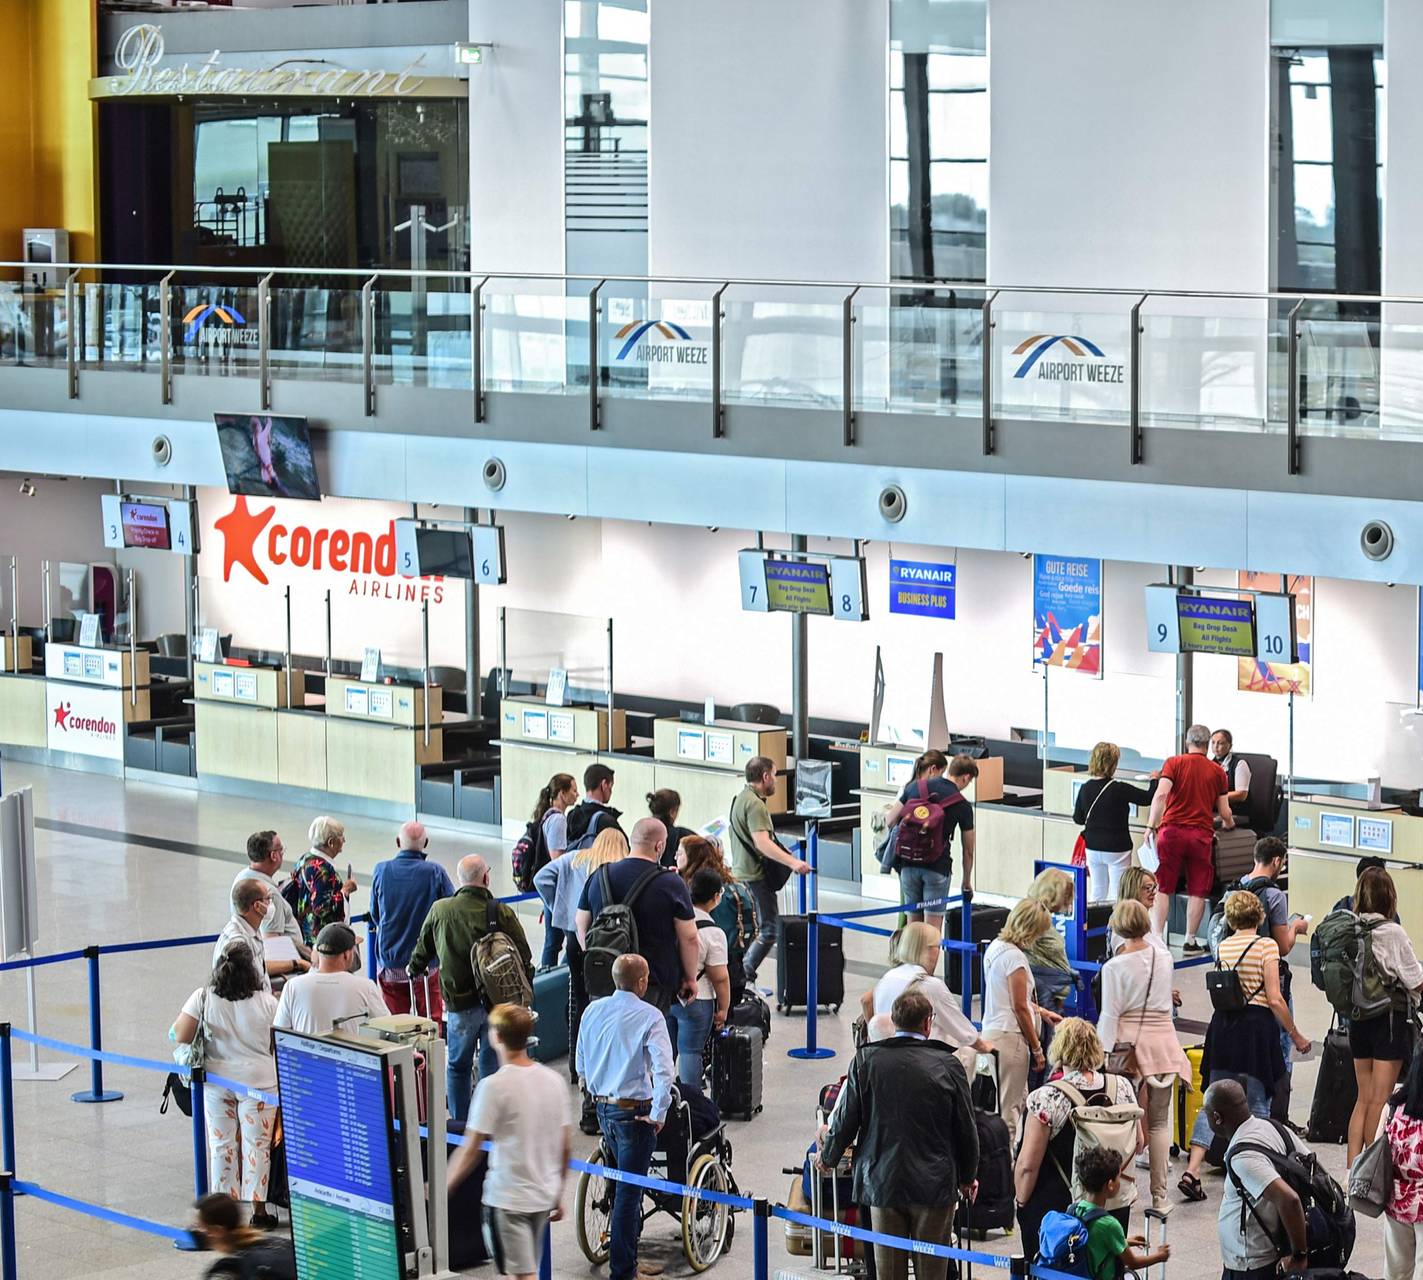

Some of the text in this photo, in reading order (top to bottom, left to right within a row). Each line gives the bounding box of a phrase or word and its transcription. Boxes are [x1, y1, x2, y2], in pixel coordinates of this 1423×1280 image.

[115, 23, 427, 97] Restaurant
[199, 327, 259, 345] AIRPORT WEEZE
[636, 344, 708, 364] AIRPORT WEEZE
[1038, 361, 1124, 383] AIRPORT WEEZE
[110, 524, 117, 540] 3
[177, 531, 185, 547] 4
[268, 519, 444, 582] corend
[404, 551, 412, 568] 5
[481, 559, 491, 576] 6
[767, 566, 825, 578] RYANAIR
[900, 567, 952, 583] RYANAIR
[1045, 560, 1089, 577] GUTE REISE
[348, 578, 444, 604] AIRLINES
[749, 585, 758, 604] 7
[1058, 581, 1084, 593] Goede
[841, 594, 852, 613] 8
[898, 591, 948, 609] BUSINESS PLUS
[1179, 602, 1249, 617] RYANAIR
[1157, 623, 1168, 643] 9
[1206, 623, 1222, 633] Drop
[1211, 635, 1232, 643] Flights
[1263, 635, 1283, 655] 10
[70, 716, 116, 735] corendon
[830, 1225, 852, 1235] WEEZE
[912, 1244, 935, 1254] WEEZE
